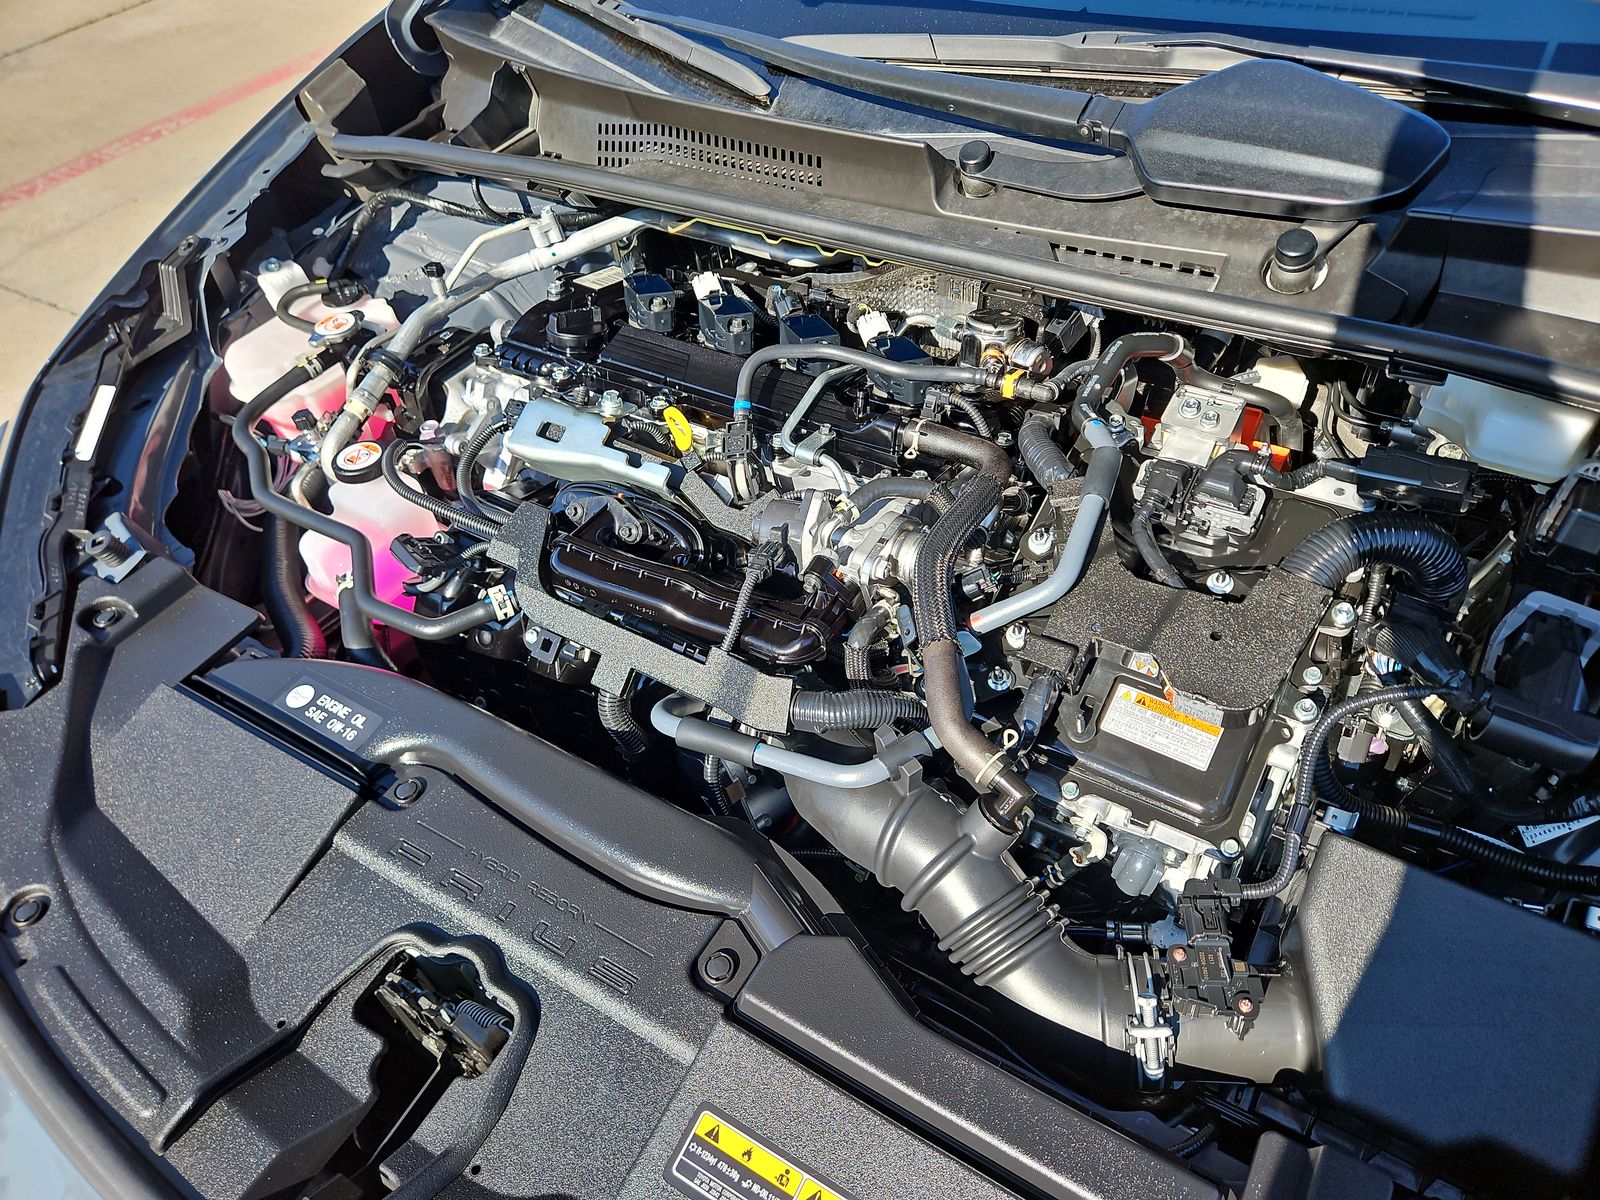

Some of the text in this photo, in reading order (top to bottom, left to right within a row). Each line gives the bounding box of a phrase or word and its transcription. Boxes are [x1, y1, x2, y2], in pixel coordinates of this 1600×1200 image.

[304, 706, 358, 741] SAE 0W-16
[316, 694, 367, 730] ENGINE OIL
[465, 847, 592, 926] HYBRID REBORN
[387, 837, 641, 996] PRIUS
